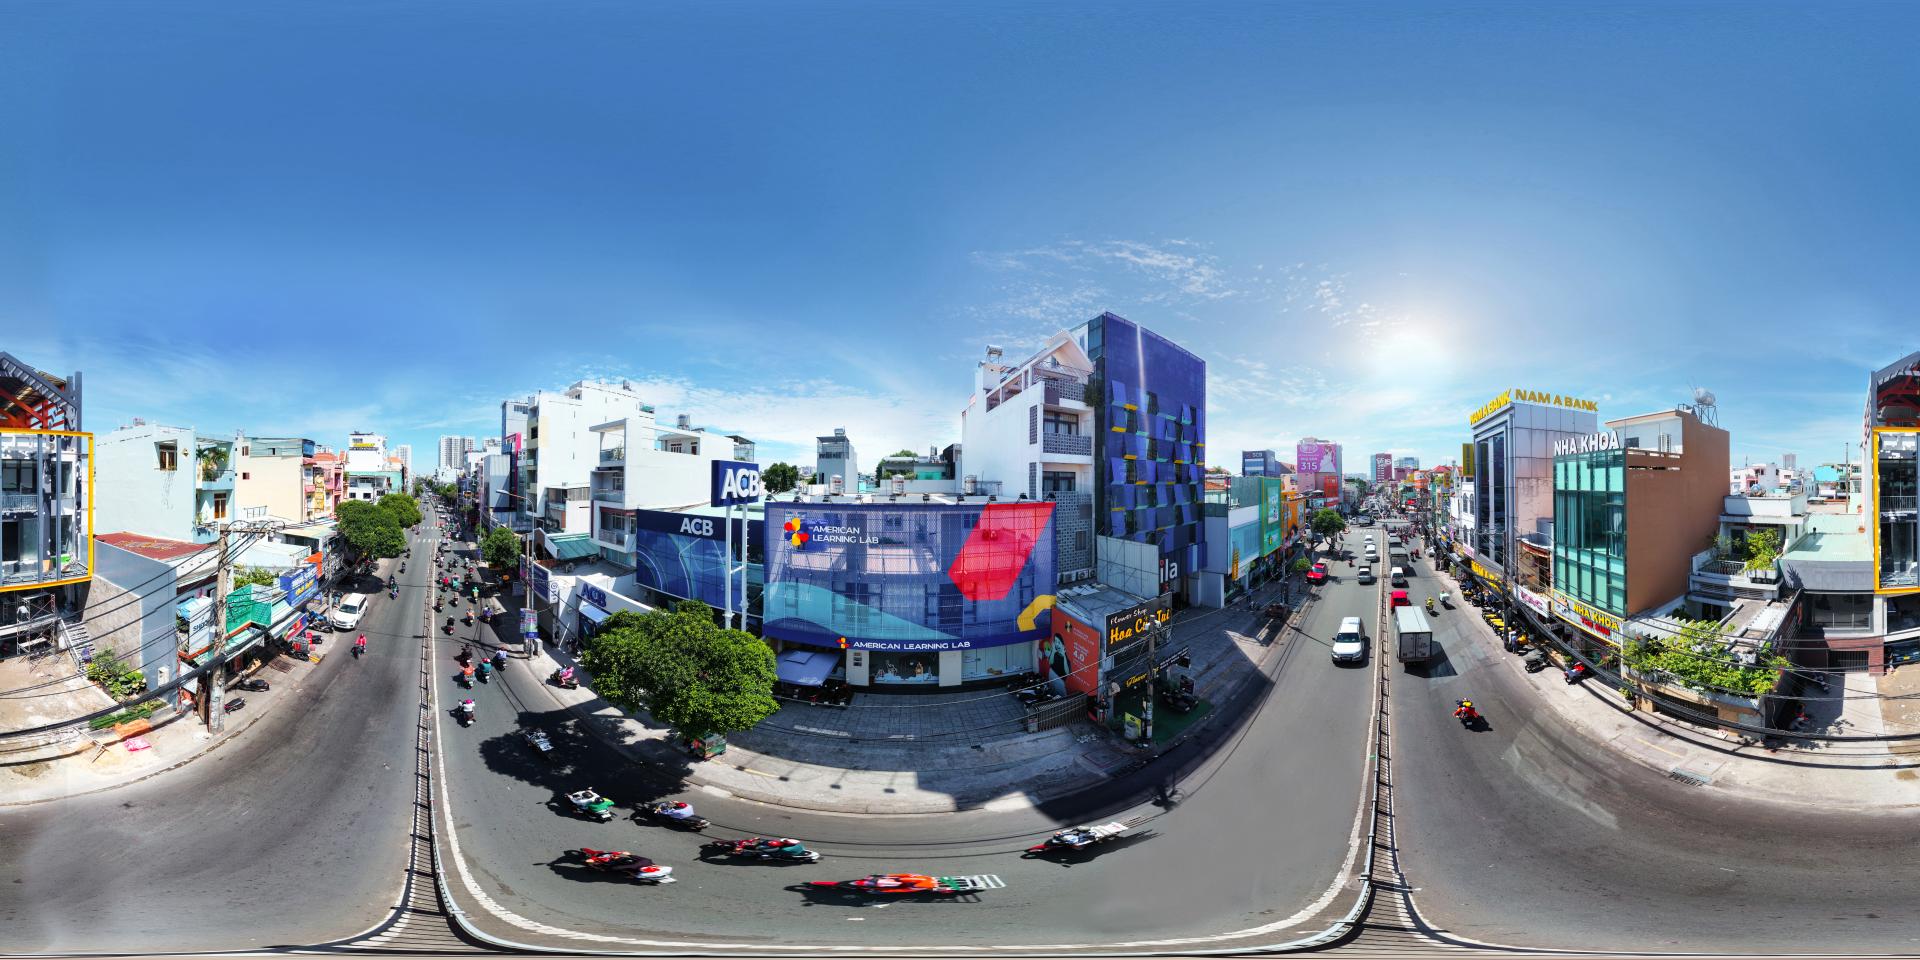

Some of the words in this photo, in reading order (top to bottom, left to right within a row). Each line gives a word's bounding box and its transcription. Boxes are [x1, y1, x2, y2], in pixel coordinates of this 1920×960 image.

[1515, 389, 1550, 404] NAM
[1554, 395, 1562, 406] A
[1564, 396, 1598, 412] BANK
[1553, 438, 1578, 456] NHA
[1580, 430, 1620, 454] KHOA
[1301, 462, 1318, 471] 315
[720, 468, 759, 499] ACB
[680, 518, 714, 536] ACB
[812, 525, 860, 534] AMERICAN
[812, 534, 857, 544] LEARNING
[859, 536, 879, 544] LAB
[1160, 559, 1178, 583] ila
[581, 582, 607, 608] ACB
[1110, 613, 1132, 625] Flower
[1133, 608, 1147, 617] Shop
[1573, 603, 1591, 619] NHA
[1592, 612, 1620, 632] KHOA
[1110, 626, 1133, 645] Hoa
[853, 641, 901, 650] AMERICAN
[903, 642, 949, 650] LEARNING
[952, 641, 971, 649] LAB
